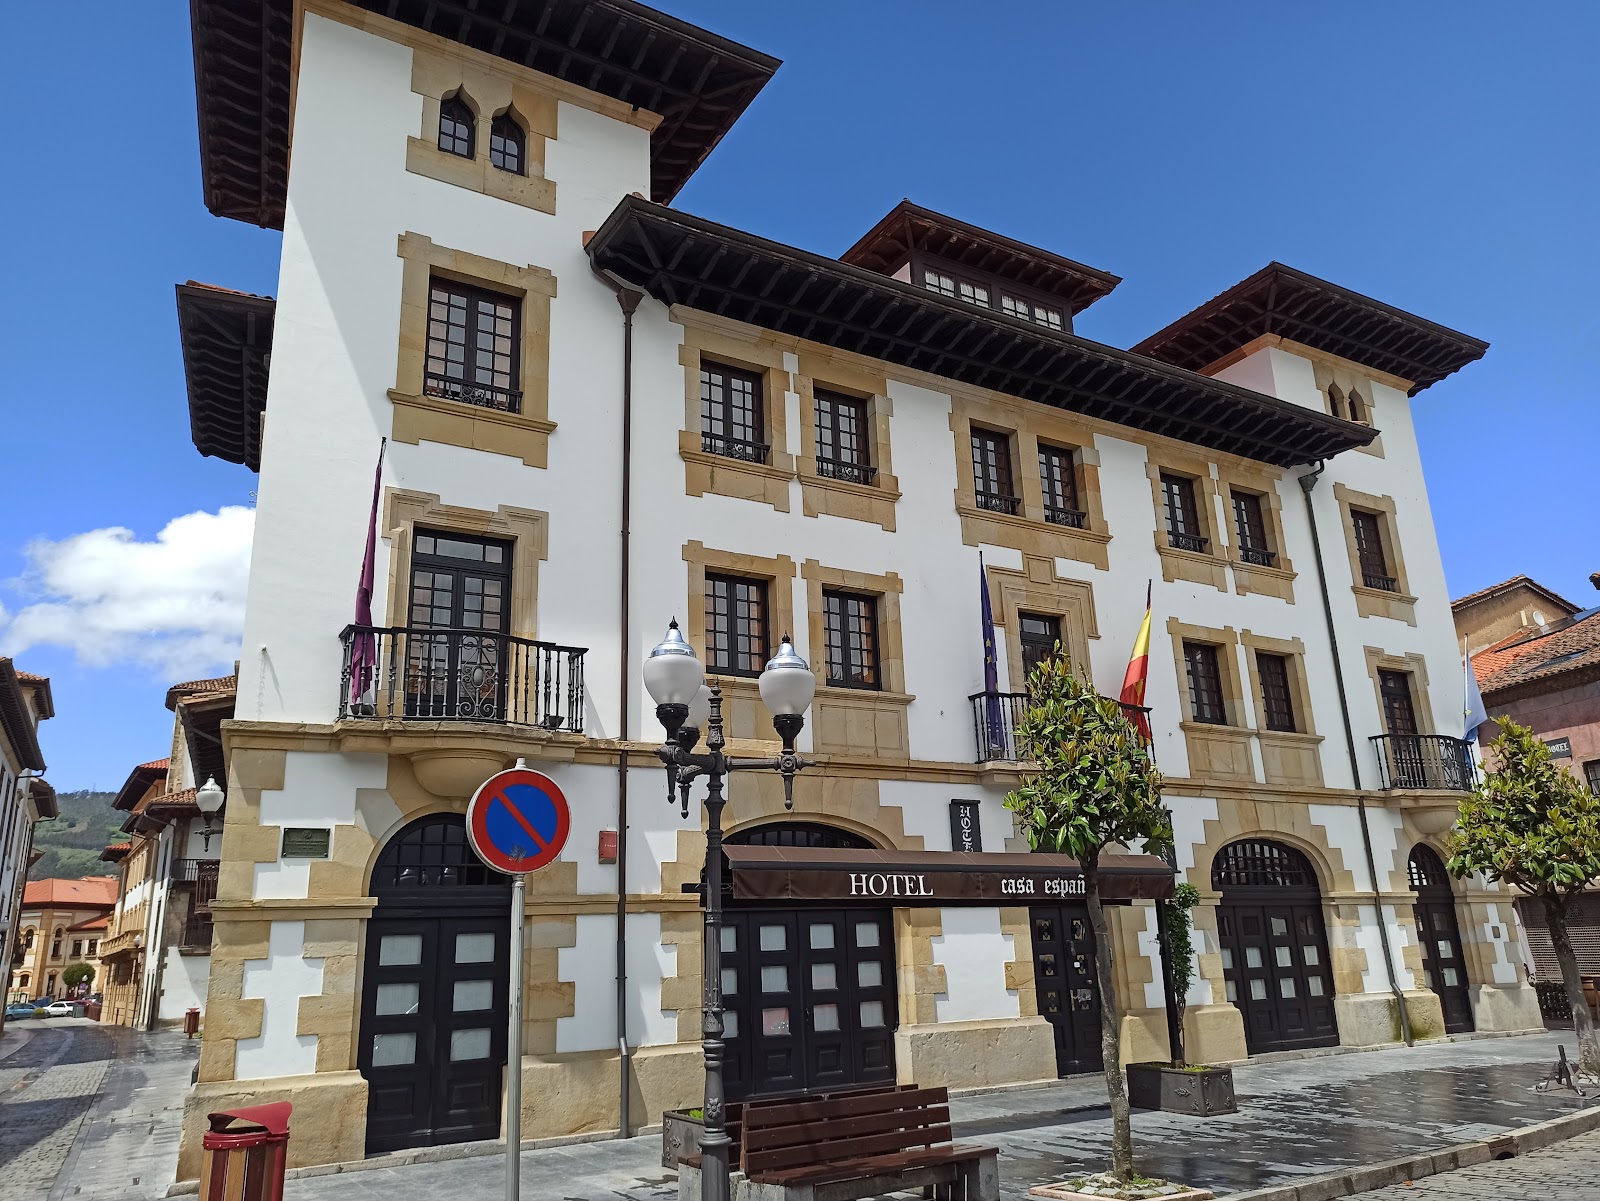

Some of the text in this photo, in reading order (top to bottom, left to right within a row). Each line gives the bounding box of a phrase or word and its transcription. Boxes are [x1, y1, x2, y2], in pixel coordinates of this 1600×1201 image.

[959, 805, 974, 853] HOTE
[849, 873, 1087, 898] HOTEL casa españ
